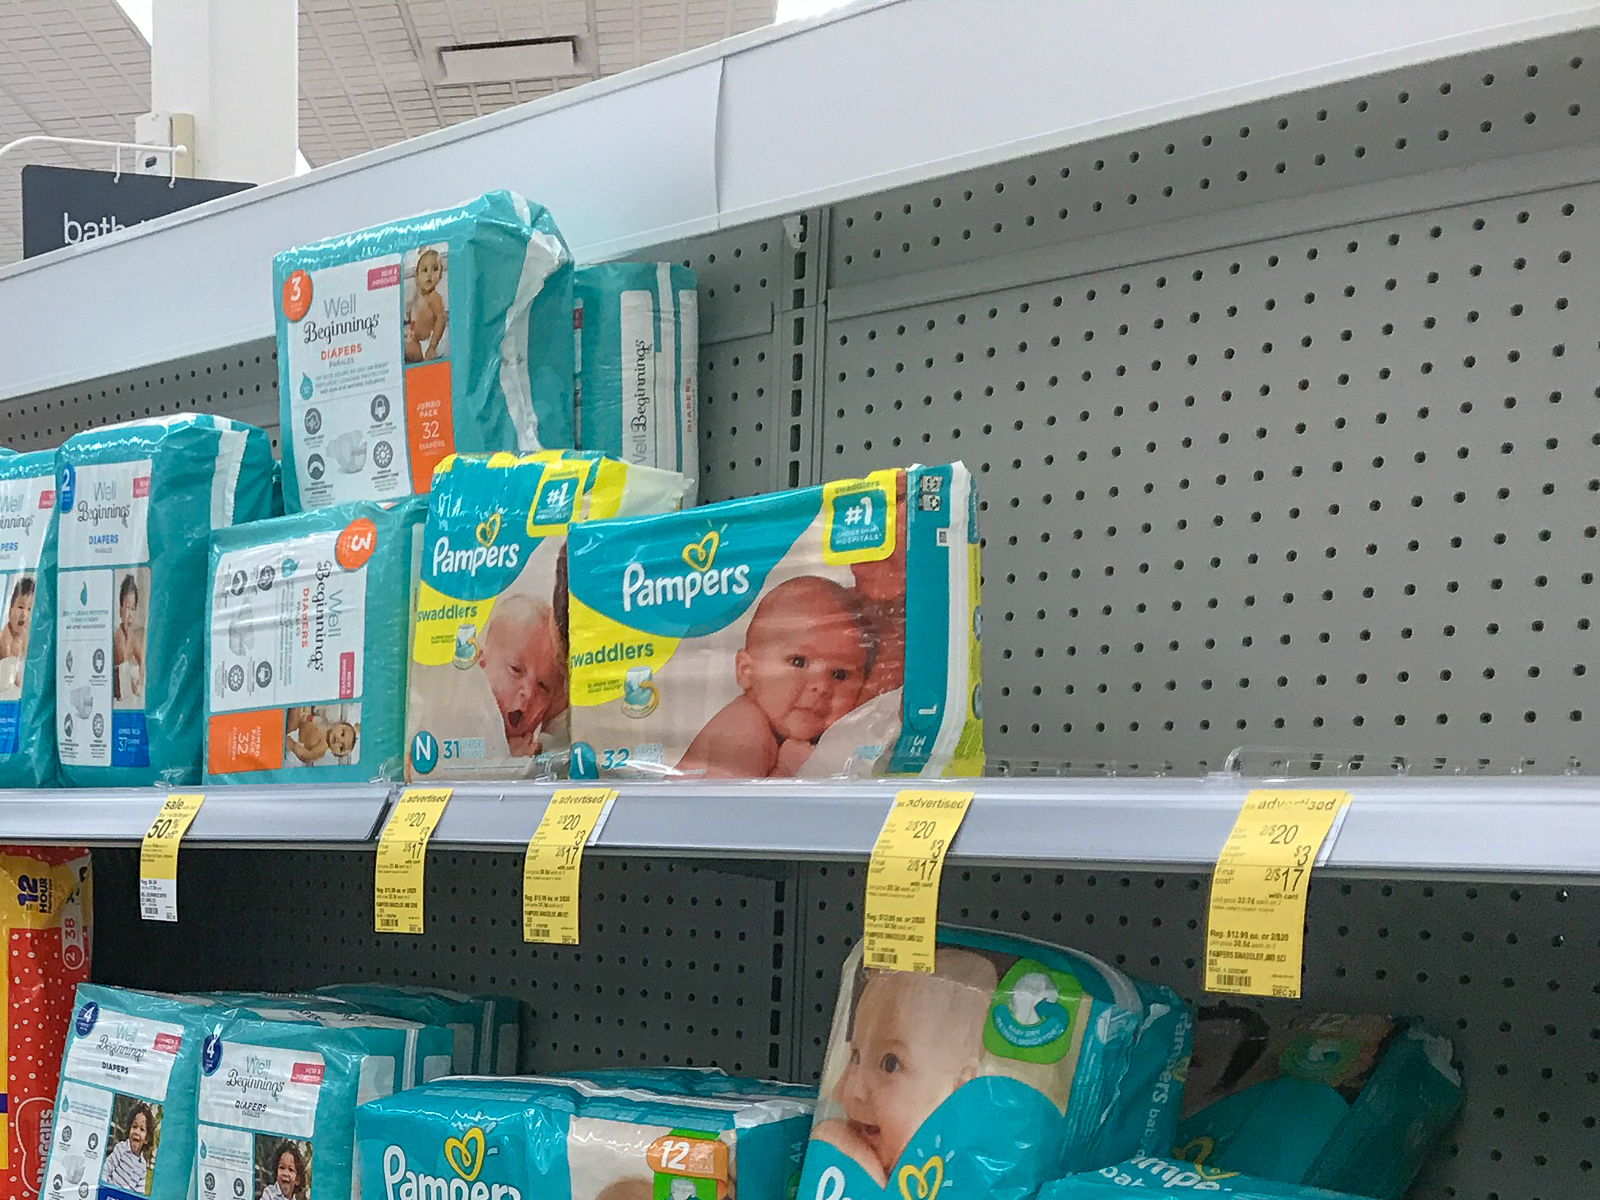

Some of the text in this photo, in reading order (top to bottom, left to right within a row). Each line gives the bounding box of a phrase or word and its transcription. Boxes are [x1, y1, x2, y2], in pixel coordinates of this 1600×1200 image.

[324, 294, 357, 319] Well
[304, 314, 379, 344] Beginnings
[321, 343, 363, 360] DIAPERS
[417, 400, 441, 411] JUMBO
[419, 409, 438, 418] PACK
[422, 421, 440, 440] 32
[93, 481, 117, 501] Well
[1, 494, 24, 512] Well
[844, 498, 872, 525] #1
[89, 535, 118, 545] DIAPERS
[432, 536, 519, 578] Pampers
[622, 562, 750, 612] Pampers
[301, 588, 309, 648] DIAPERS
[308, 561, 333, 672] Beginnings
[328, 589, 343, 637] Well
[416, 604, 478, 624] swaddlers
[442, 740, 460, 759] 31
[602, 749, 630, 768] 32
[164, 799, 184, 810] sale
[407, 793, 446, 804] advertised
[559, 794, 604, 805] advertised
[906, 798, 966, 809] advertised
[930, 840, 944, 858] $3
[1294, 845, 1311, 867] $3
[116, 1024, 138, 1042] Well
[96, 1034, 147, 1062] Beginnings
[101, 1062, 129, 1075] DIAPERS
[246, 1056, 271, 1077] Well
[226, 1068, 285, 1101] Beginnings
[235, 1100, 267, 1113] DIAPERS
[660, 1140, 688, 1170] 12
